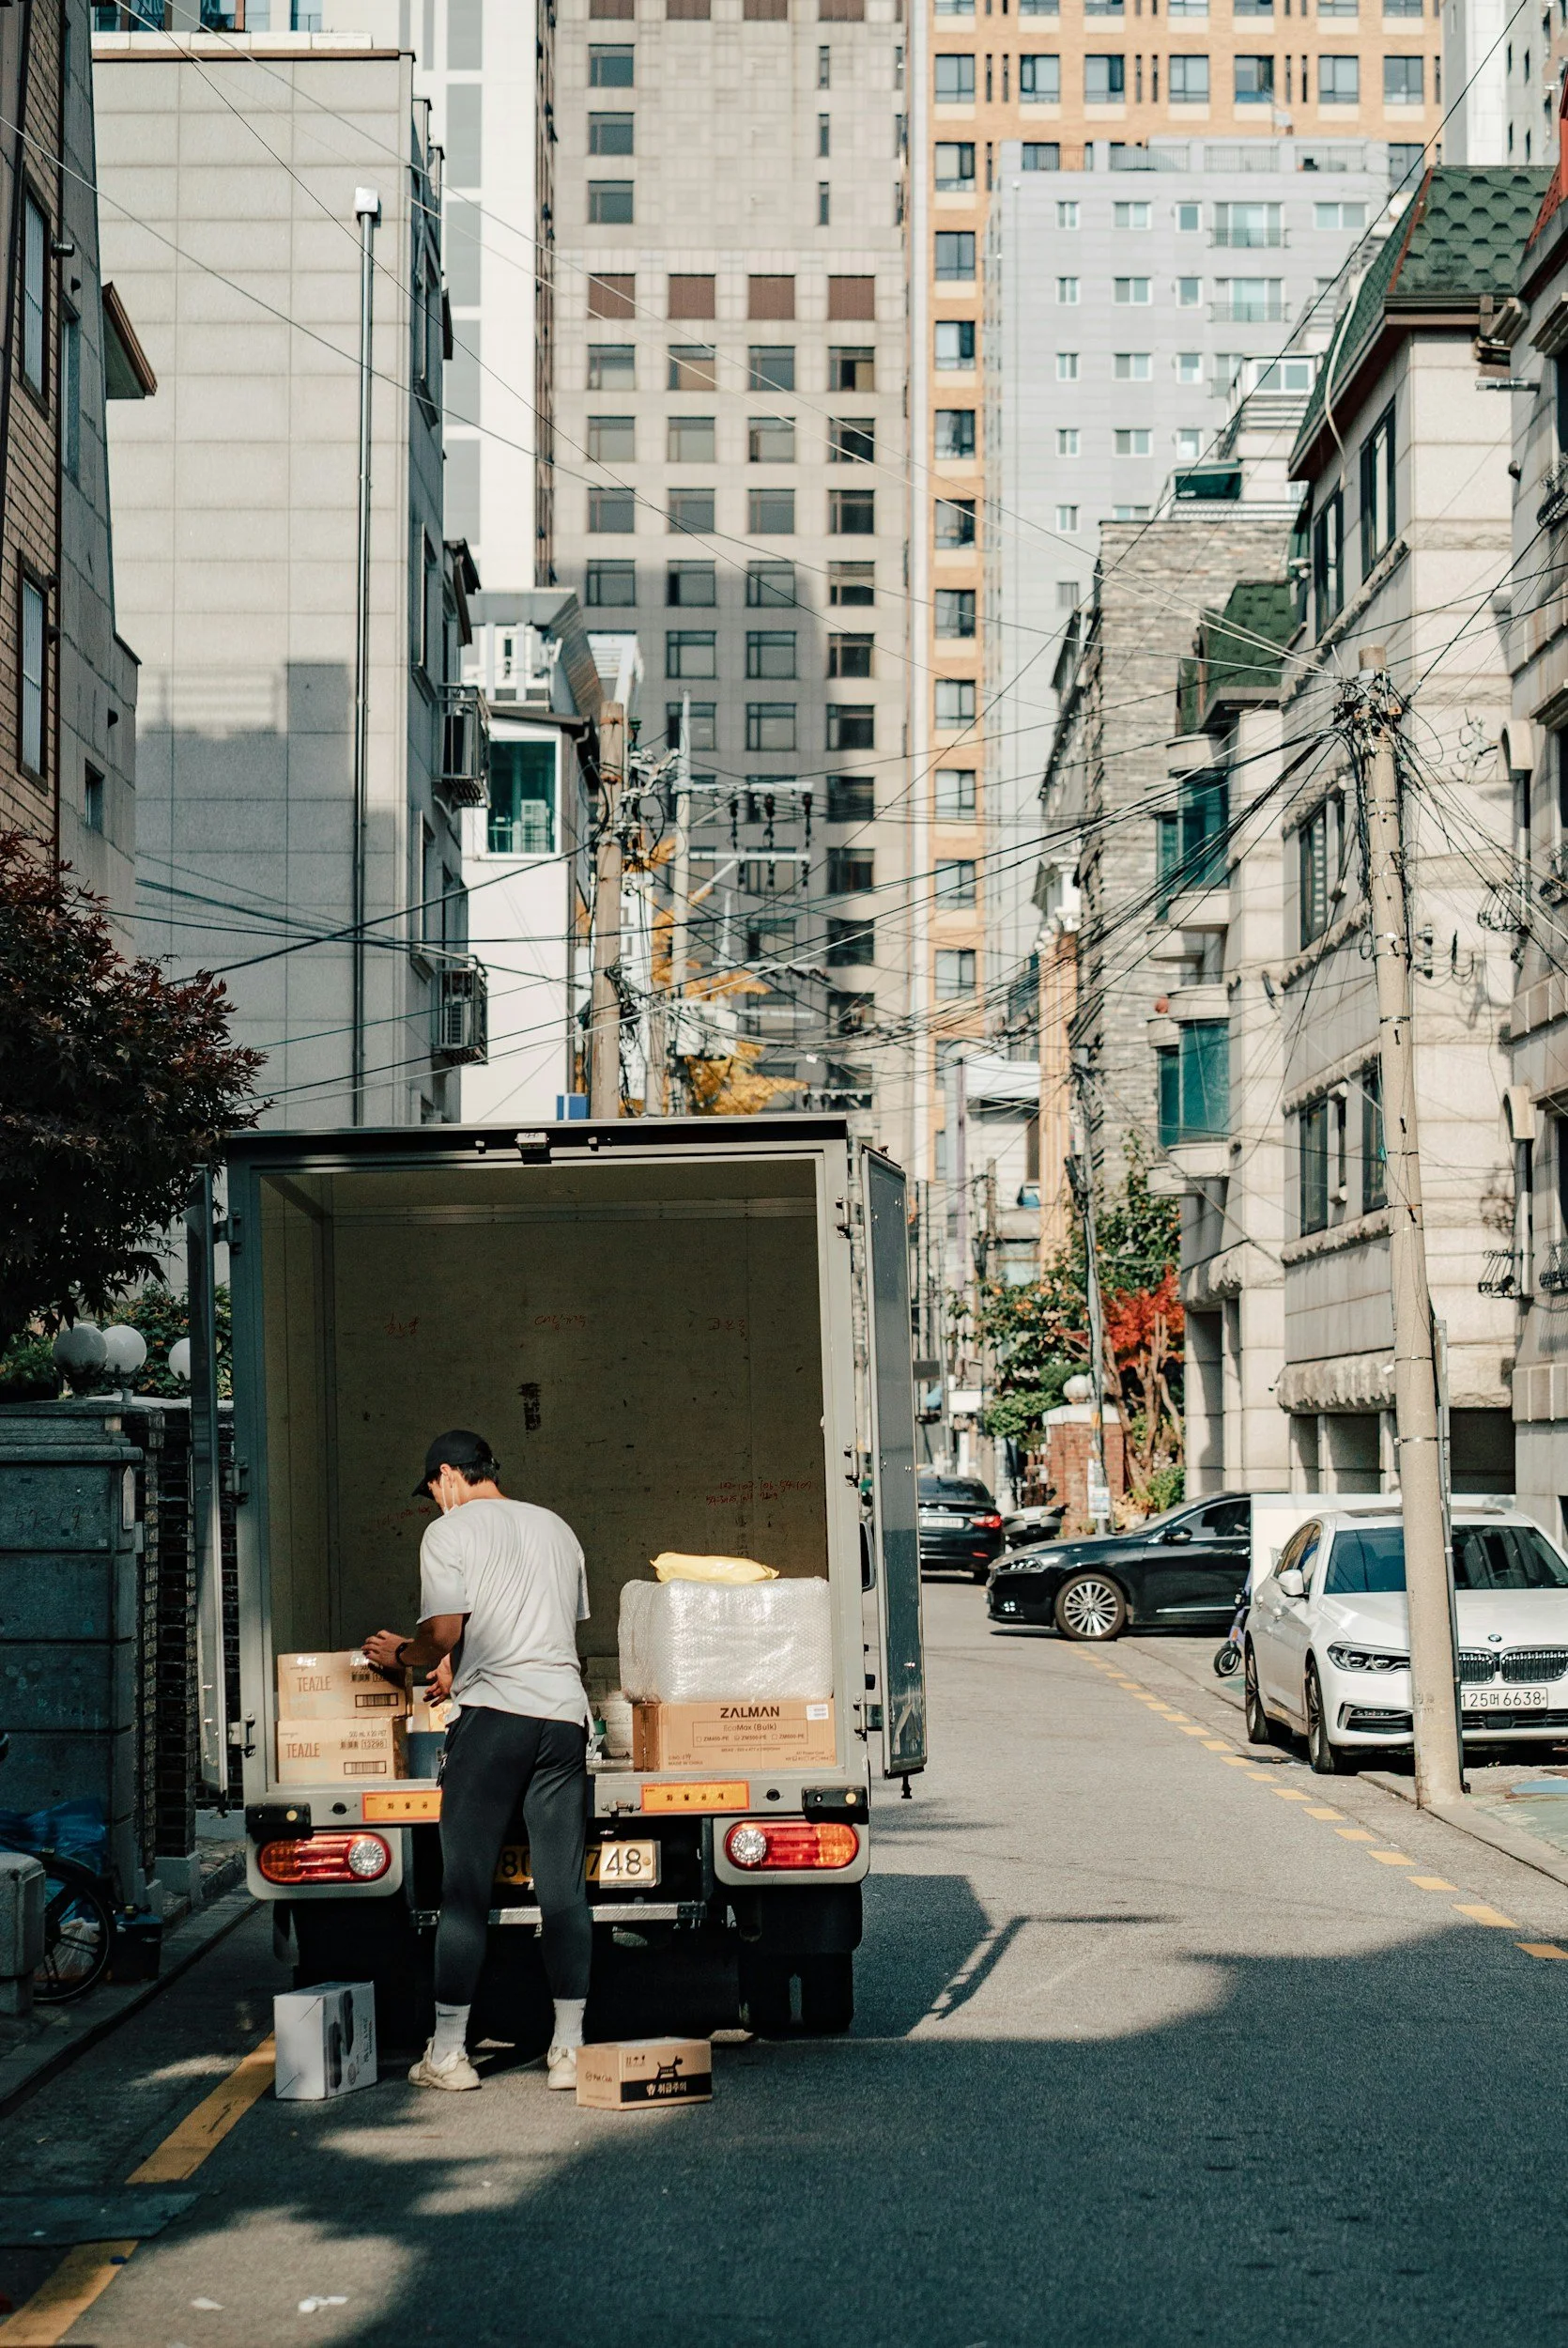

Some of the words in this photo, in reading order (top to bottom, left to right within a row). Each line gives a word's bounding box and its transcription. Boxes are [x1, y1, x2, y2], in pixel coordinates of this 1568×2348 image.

[297, 1676, 331, 1691] TEAZLE
[1503, 1691, 1542, 1707] 6638
[720, 1707, 780, 1719] ZALMAN
[753, 1722, 777, 1732] (Bulk)
[285, 1742, 320, 1758] TEAZLE
[586, 1847, 642, 1877] 748
[657, 2080, 687, 2094] 취급주의
